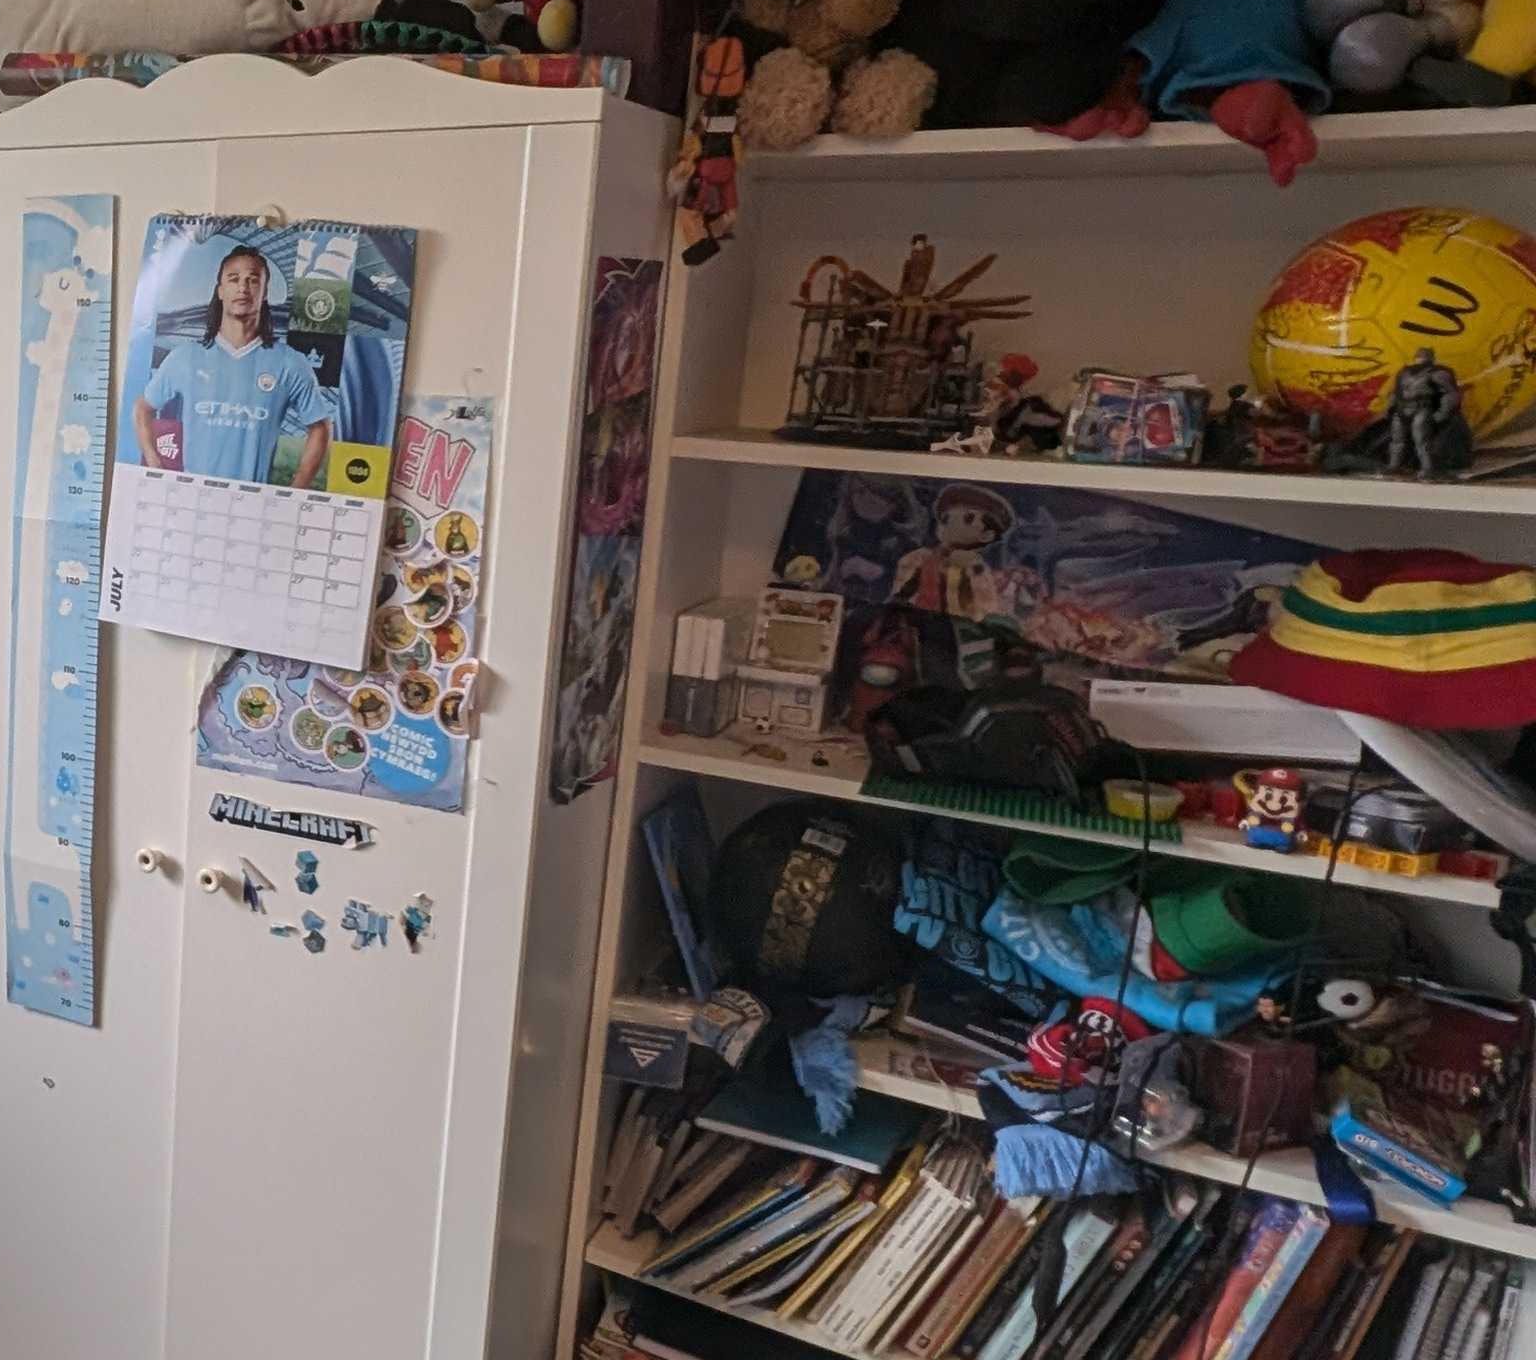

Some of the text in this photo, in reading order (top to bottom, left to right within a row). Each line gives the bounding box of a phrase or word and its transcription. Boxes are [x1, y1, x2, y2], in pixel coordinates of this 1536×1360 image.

[76, 298, 91, 307] 150
[73, 393, 89, 402] 140
[195, 400, 270, 422] ETIHAD
[68, 486, 83, 495] 130
[66, 576, 81, 586] 120
[109, 567, 124, 612] JULY
[64, 665, 76, 674] 110
[390, 724, 435, 748] COMIC
[61, 752, 76, 762] 100
[210, 793, 371, 846] MINECRAFT
[58, 837, 70, 846] 90
[58, 918, 71, 928] 80
[1000, 911, 1041, 962] CIT
[60, 997, 72, 1008] 70
